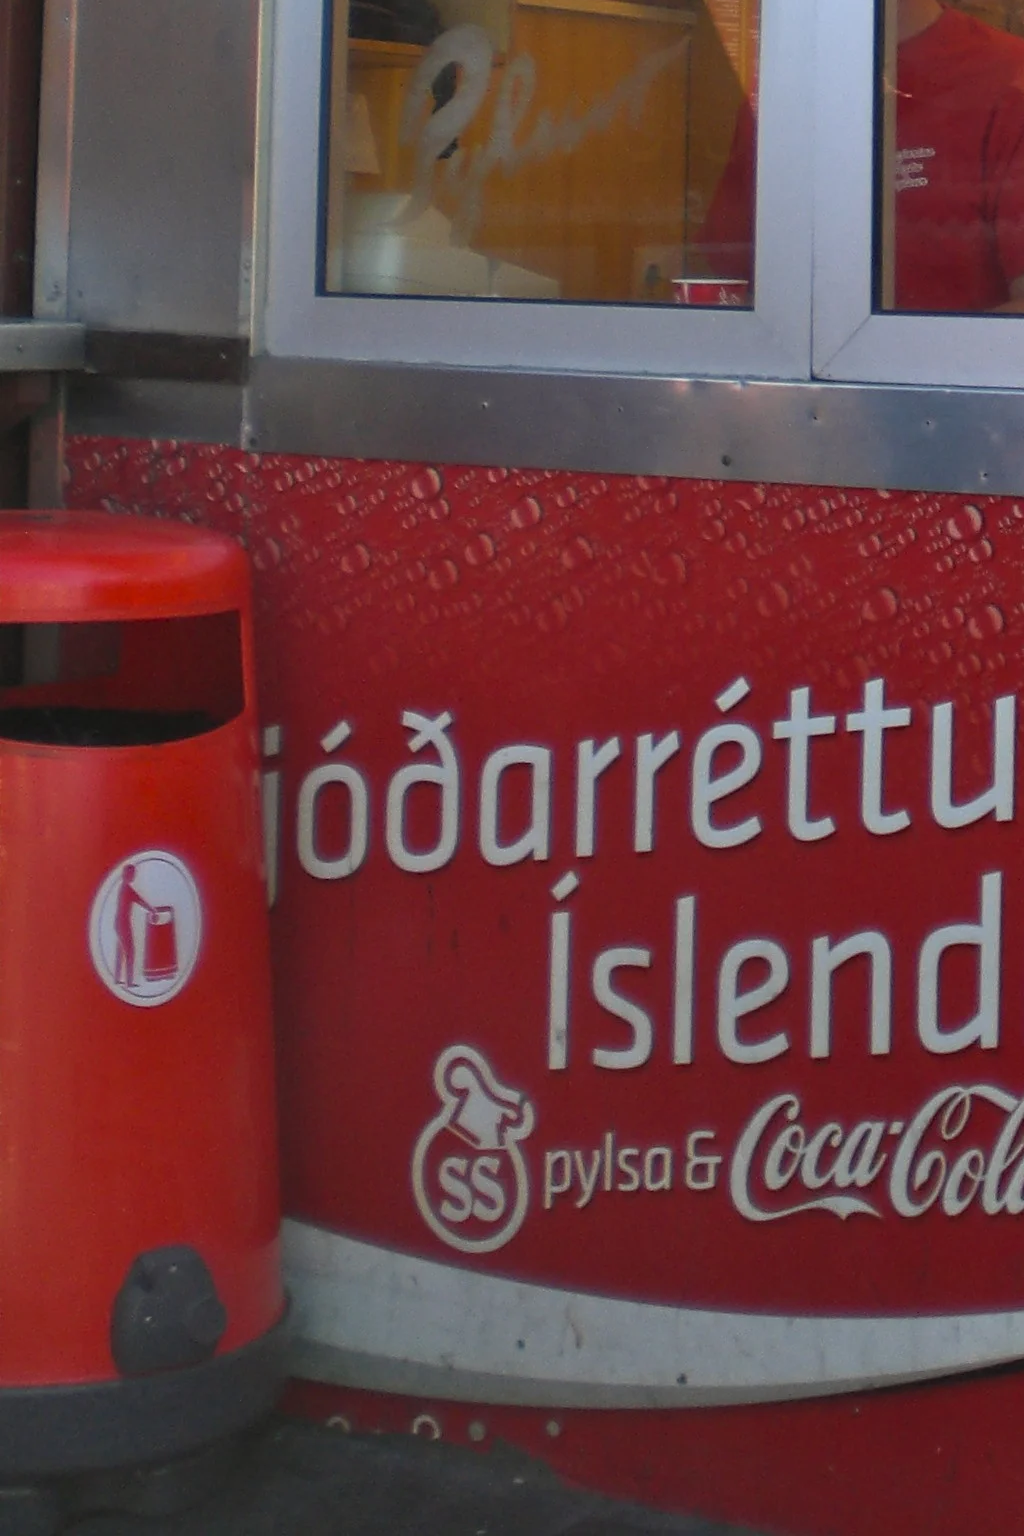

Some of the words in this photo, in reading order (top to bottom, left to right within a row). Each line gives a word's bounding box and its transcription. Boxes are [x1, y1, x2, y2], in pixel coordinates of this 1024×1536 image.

[437, 1155, 506, 1223] SS
[543, 1130, 673, 1211] pylsa
[684, 1128, 723, 1192] &
